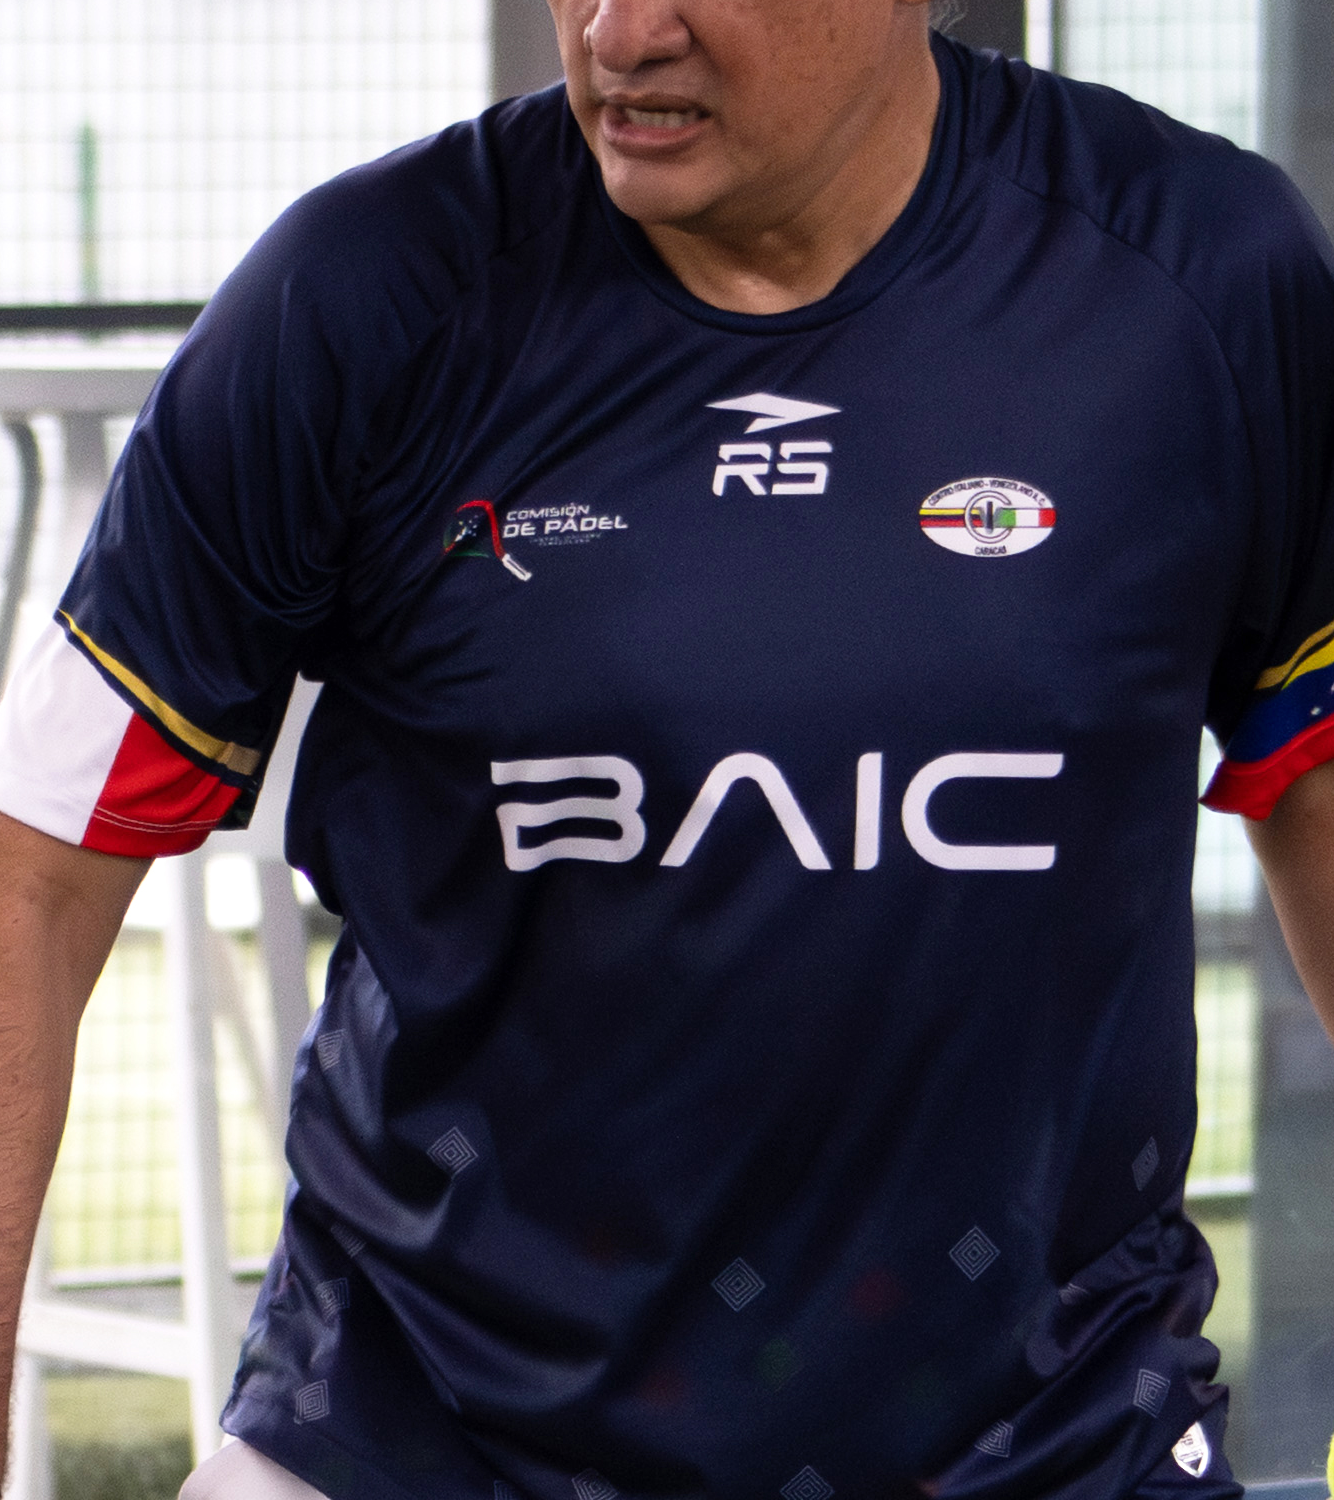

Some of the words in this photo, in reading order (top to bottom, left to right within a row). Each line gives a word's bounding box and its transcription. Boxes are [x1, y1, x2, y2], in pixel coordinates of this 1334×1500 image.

[712, 440, 833, 497] RS
[502, 522, 537, 539] DE
[506, 502, 590, 521] COMISIÓN
[491, 752, 1064, 871] BAIC
